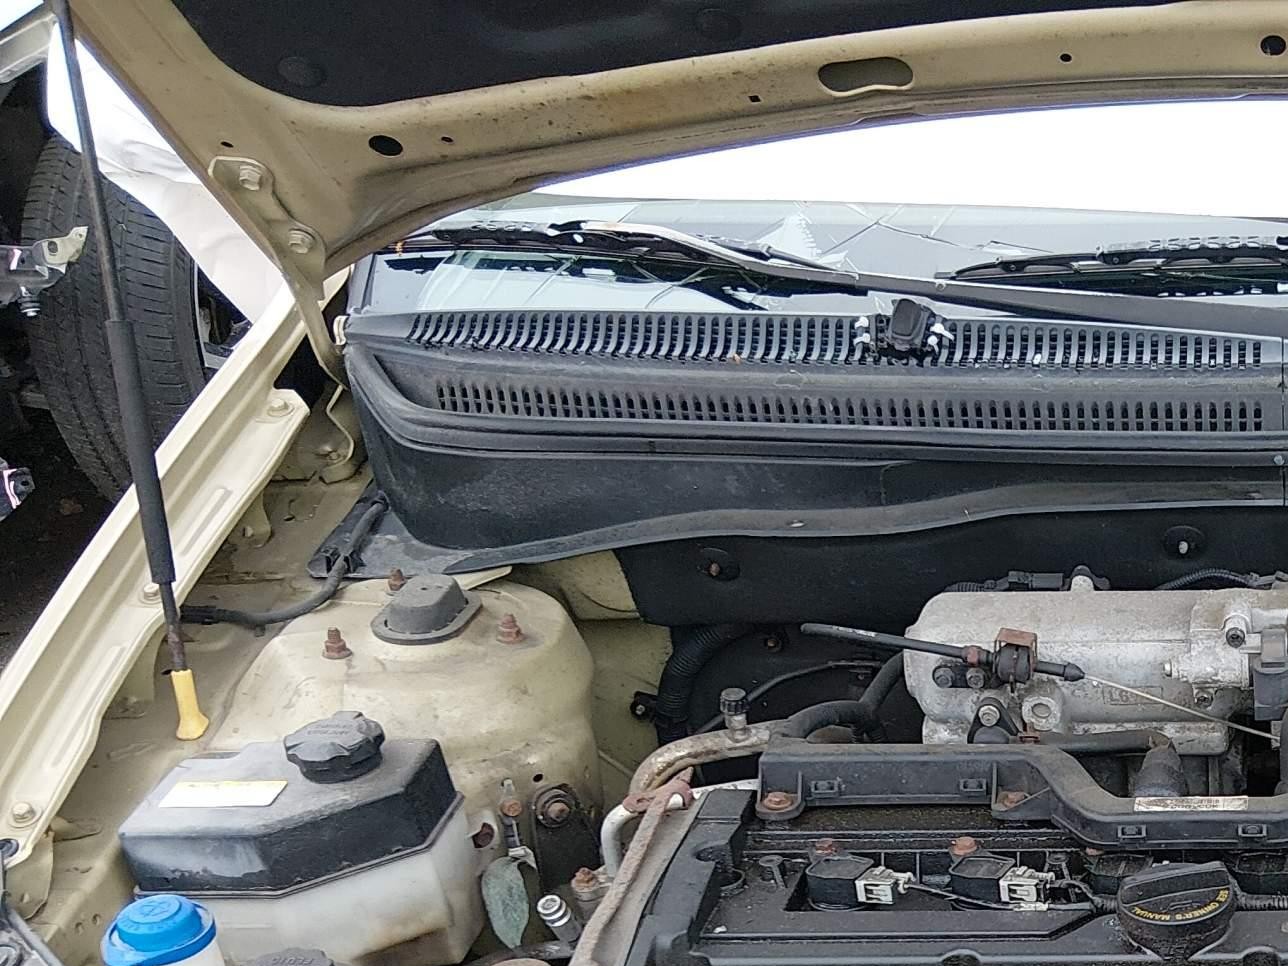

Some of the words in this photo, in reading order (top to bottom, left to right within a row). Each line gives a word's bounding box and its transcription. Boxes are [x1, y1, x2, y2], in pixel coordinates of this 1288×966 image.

[1215, 889, 1229, 902] SEE
[1131, 906, 1171, 921] MANUAL
[1175, 901, 1220, 921] OWNER'S
